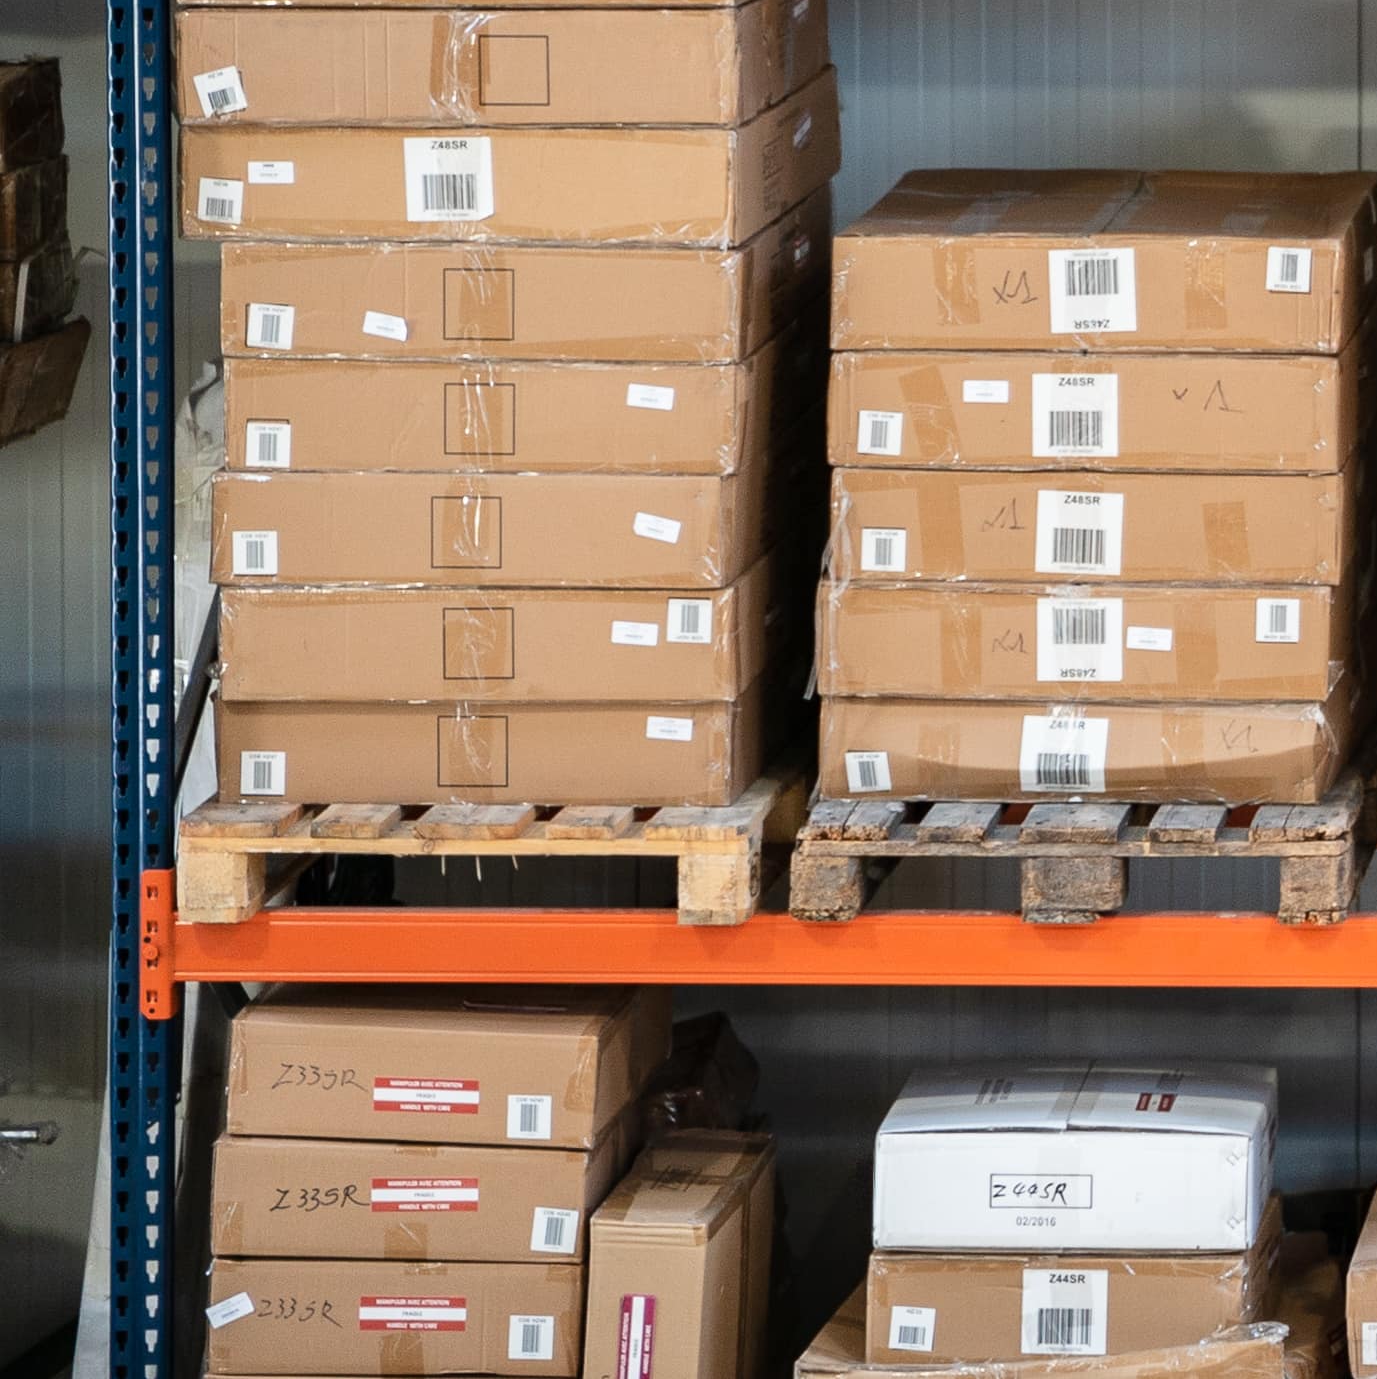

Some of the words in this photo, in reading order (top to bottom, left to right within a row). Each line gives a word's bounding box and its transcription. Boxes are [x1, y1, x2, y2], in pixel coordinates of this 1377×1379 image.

[431, 140, 468, 151] Z48SR
[1074, 318, 1110, 329] Z48SR
[1058, 377, 1095, 387] Z48SR
[1064, 495, 1101, 506] Z48SR
[1060, 668, 1097, 678] Z48SR
[1049, 720, 1086, 729] Z48R
[1016, 1216, 1057, 1227] 02/2016
[1049, 1274, 1086, 1284] Z44SR
